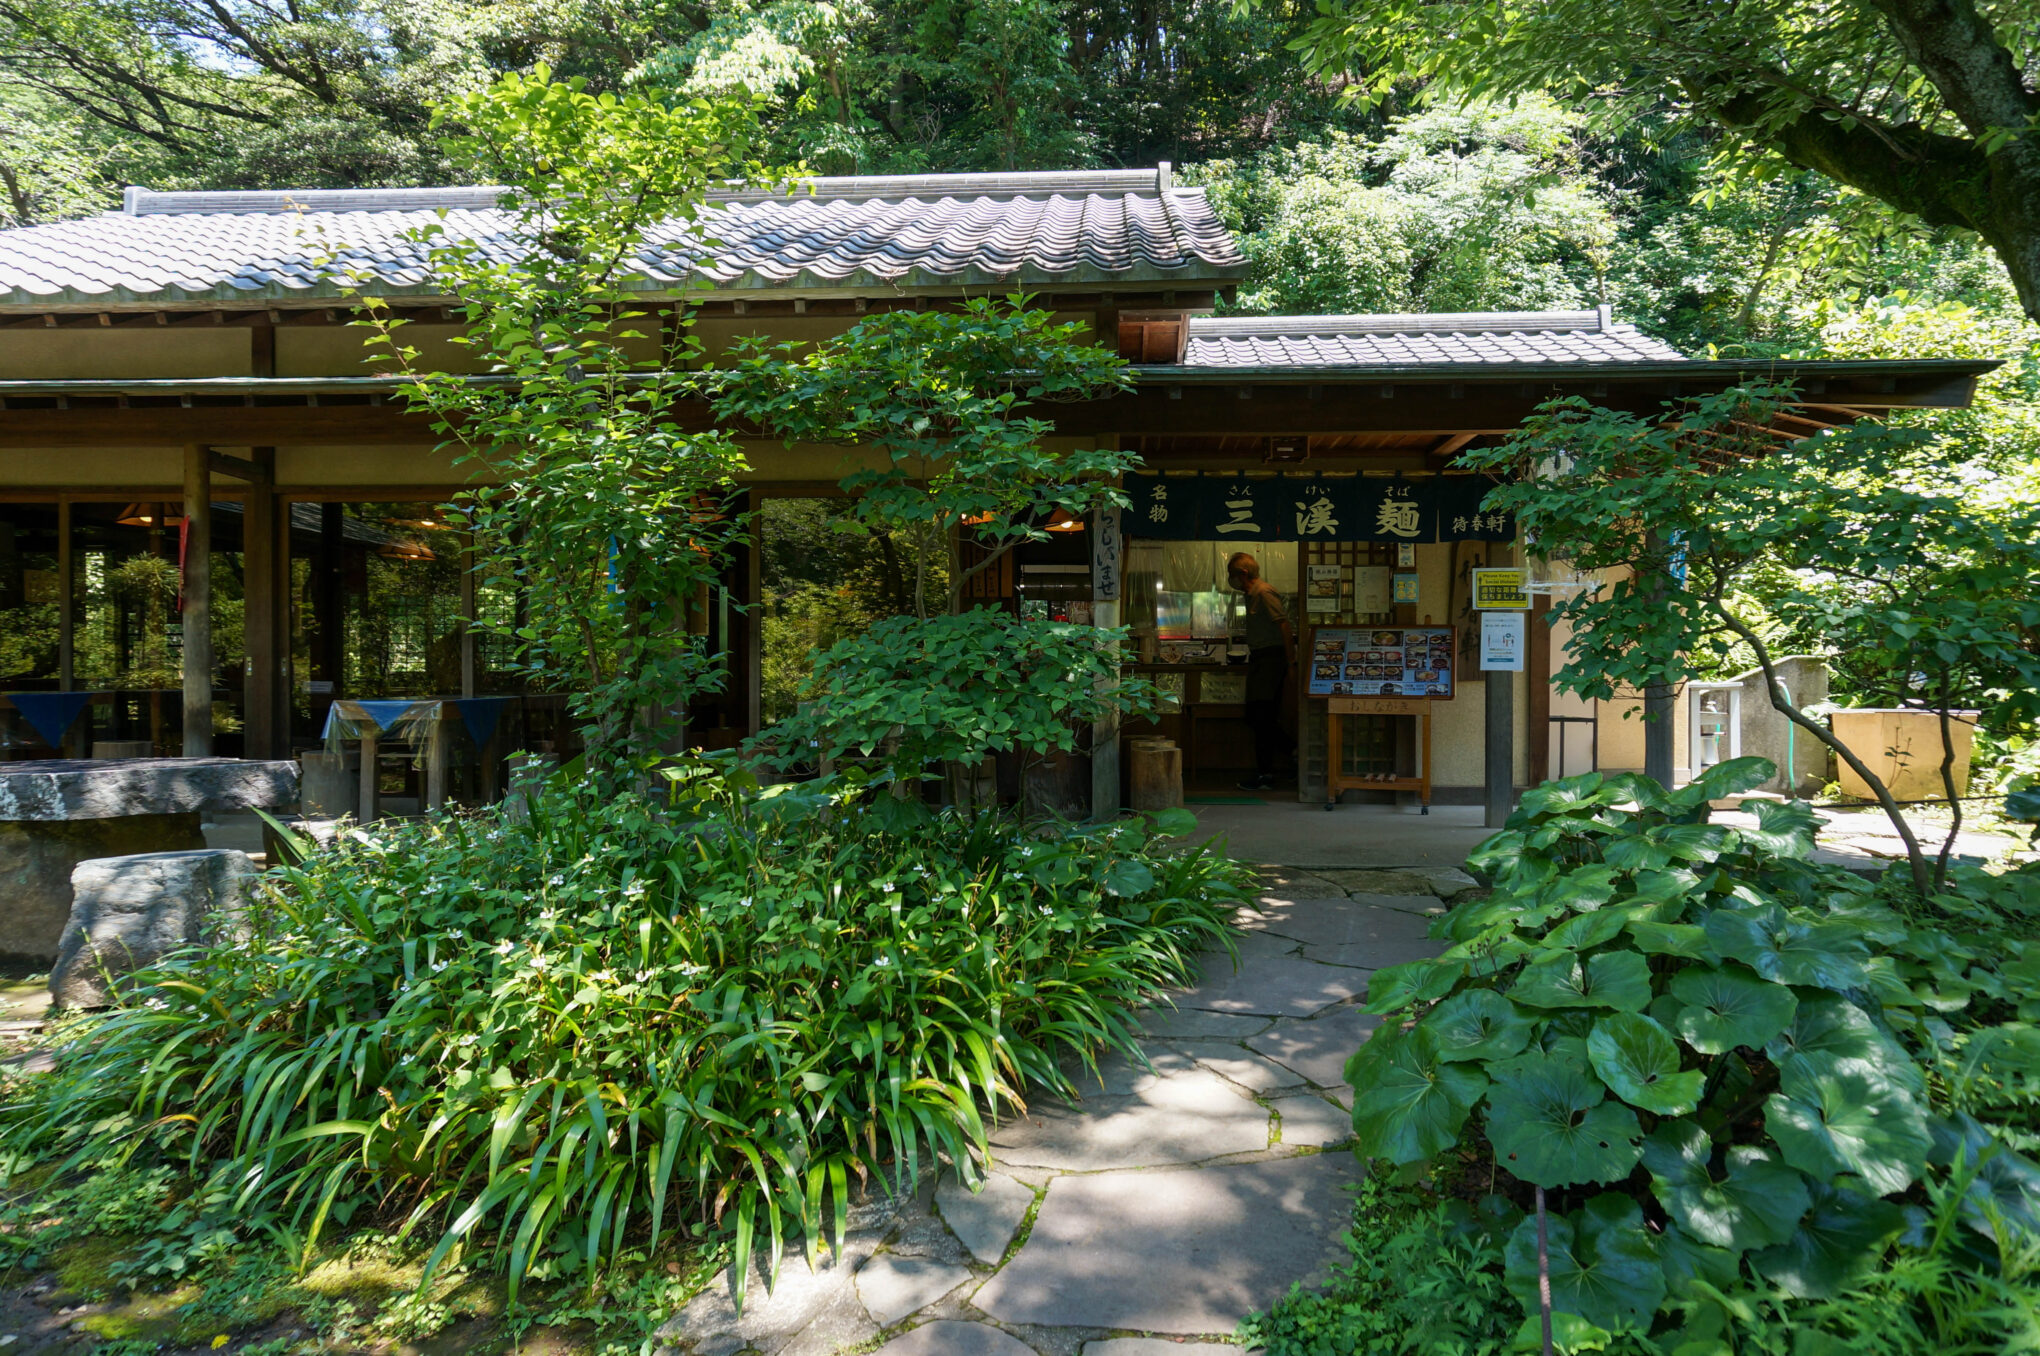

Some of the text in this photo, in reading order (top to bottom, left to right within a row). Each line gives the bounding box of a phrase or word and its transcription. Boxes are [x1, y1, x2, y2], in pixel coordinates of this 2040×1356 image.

[1228, 484, 1252, 496] さん
[1305, 484, 1331, 496] けい
[1384, 485, 1411, 497] そば
[1148, 484, 1169, 523] 名物
